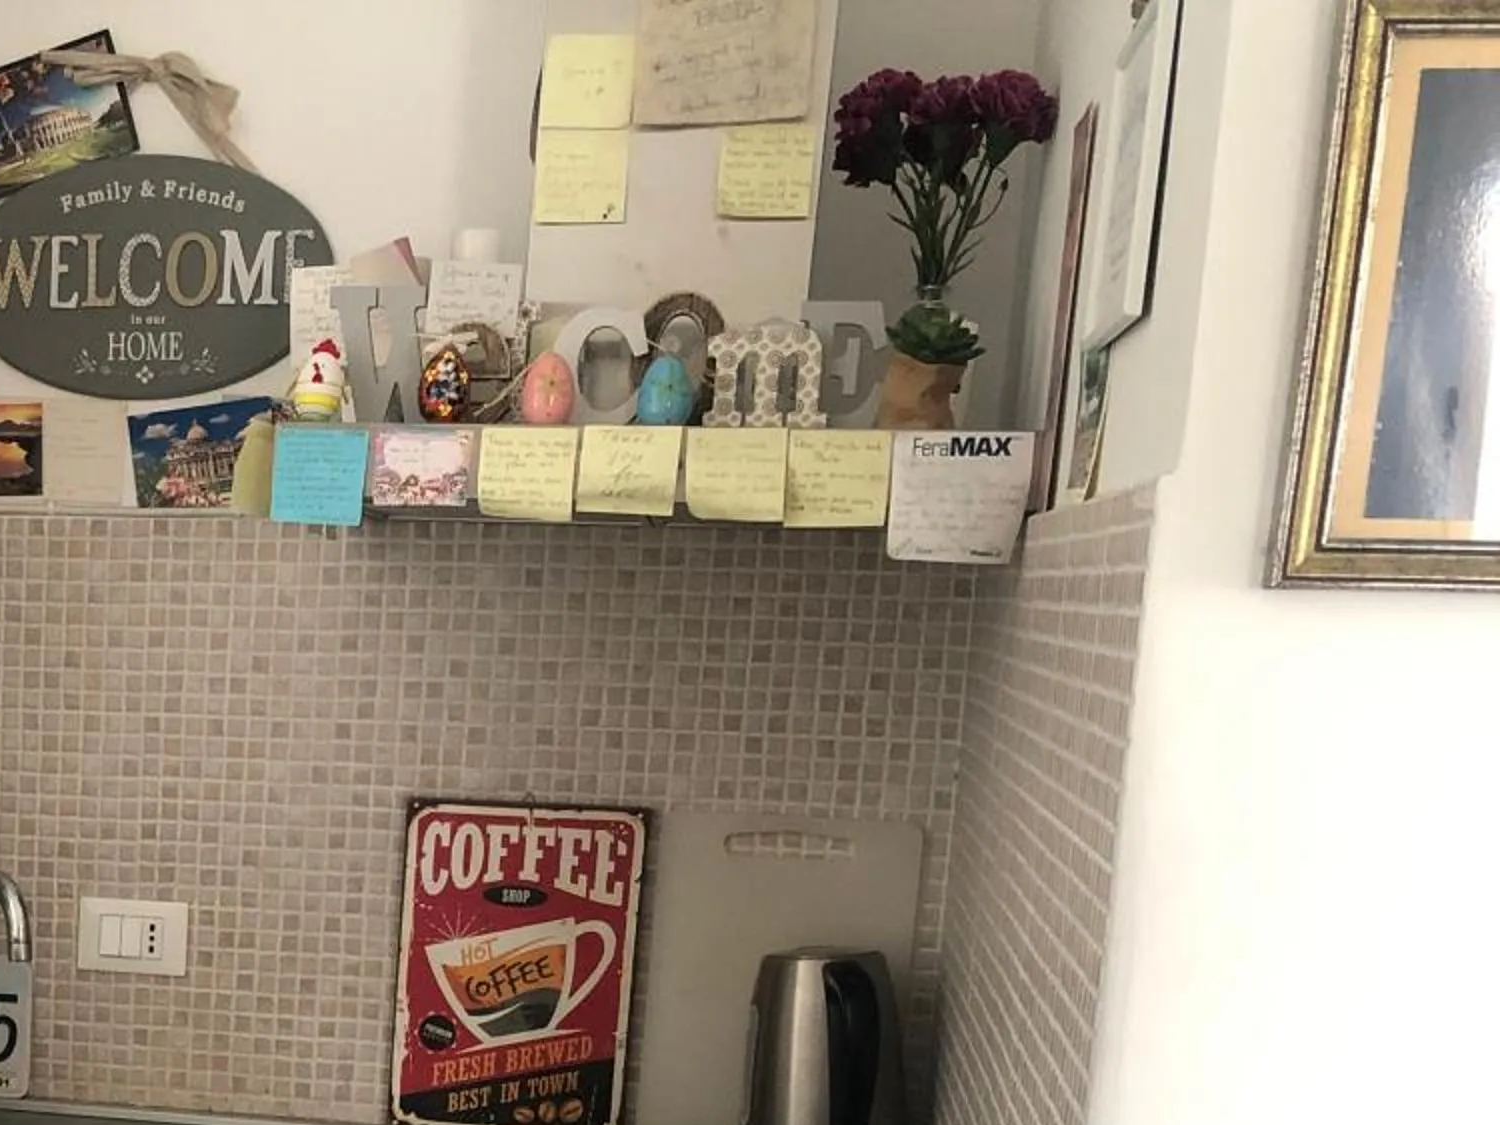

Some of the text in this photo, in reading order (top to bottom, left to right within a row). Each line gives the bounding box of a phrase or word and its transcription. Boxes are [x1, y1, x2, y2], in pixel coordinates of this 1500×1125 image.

[60, 179, 246, 213] Family & Friends
[107, 331, 184, 362] HOME
[913, 436, 1013, 457] FeraMAX
[419, 820, 628, 908] COFFEE
[502, 889, 531, 904] SHOP
[461, 938, 498, 965] HOT
[432, 1035, 593, 1087] FRESH BREWED
[447, 1071, 580, 1113] BEST IN TOWN
